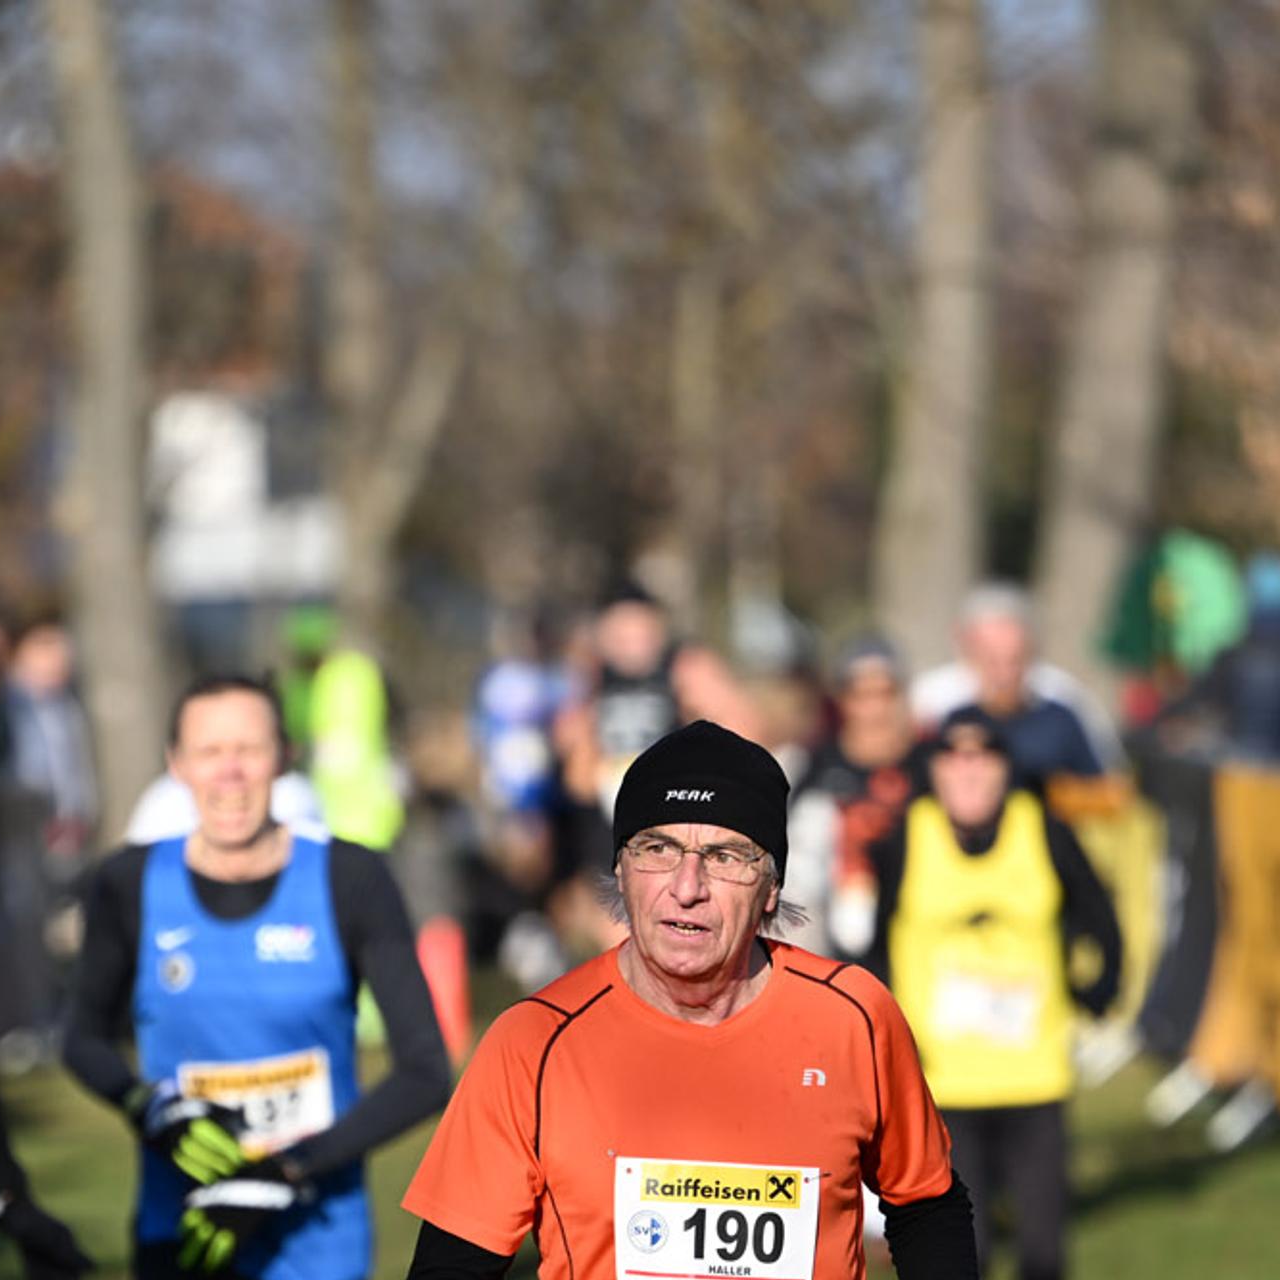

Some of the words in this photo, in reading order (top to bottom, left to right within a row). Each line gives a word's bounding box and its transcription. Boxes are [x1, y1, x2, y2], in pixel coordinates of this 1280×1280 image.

[665, 789, 715, 802] PEAK
[646, 1178, 761, 1201] Raiffeisen
[683, 1208, 785, 1264] 190
[708, 1265, 752, 1276] HALLER
